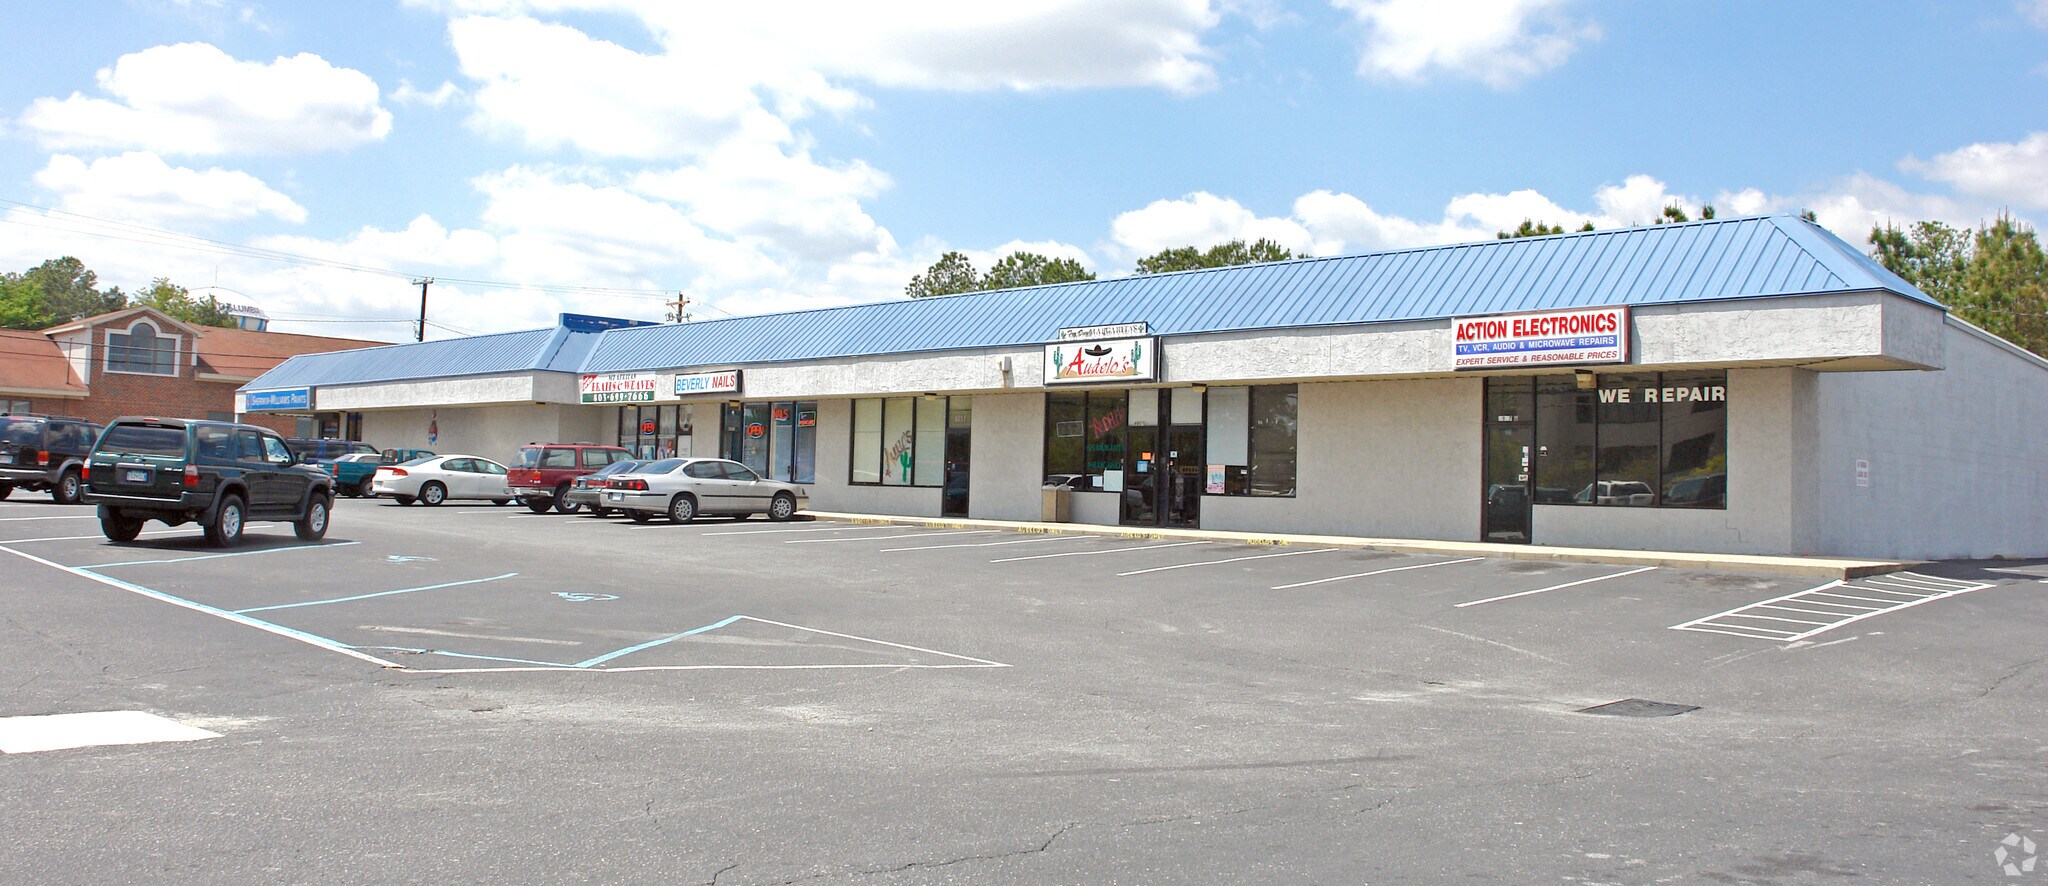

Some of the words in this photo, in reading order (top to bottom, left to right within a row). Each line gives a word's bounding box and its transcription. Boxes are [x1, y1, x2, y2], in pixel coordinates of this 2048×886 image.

[1456, 320, 1508, 341] ACTION
[1513, 313, 1617, 337] ELECTRONICS
[1492, 342, 1516, 351] AUDIO
[1519, 341, 1525, 349] &
[1528, 338, 1575, 348] MICROWAVE
[1579, 336, 1614, 346] REPAIRS
[1065, 346, 1130, 376] Audelo's
[1456, 358, 1484, 366] EXPERT
[1487, 356, 1519, 365] SERVICE
[1531, 353, 1584, 362] REASONABLE
[1587, 351, 1617, 360] PRICES
[624, 379, 655, 391] WEAVES
[676, 377, 710, 391] BEVERLY
[712, 374, 736, 388] NAILS
[1598, 388, 1630, 403] WE
[1644, 386, 1726, 403] REPAIR
[641, 422, 655, 432] OPEN
[747, 425, 764, 436] OPEN
